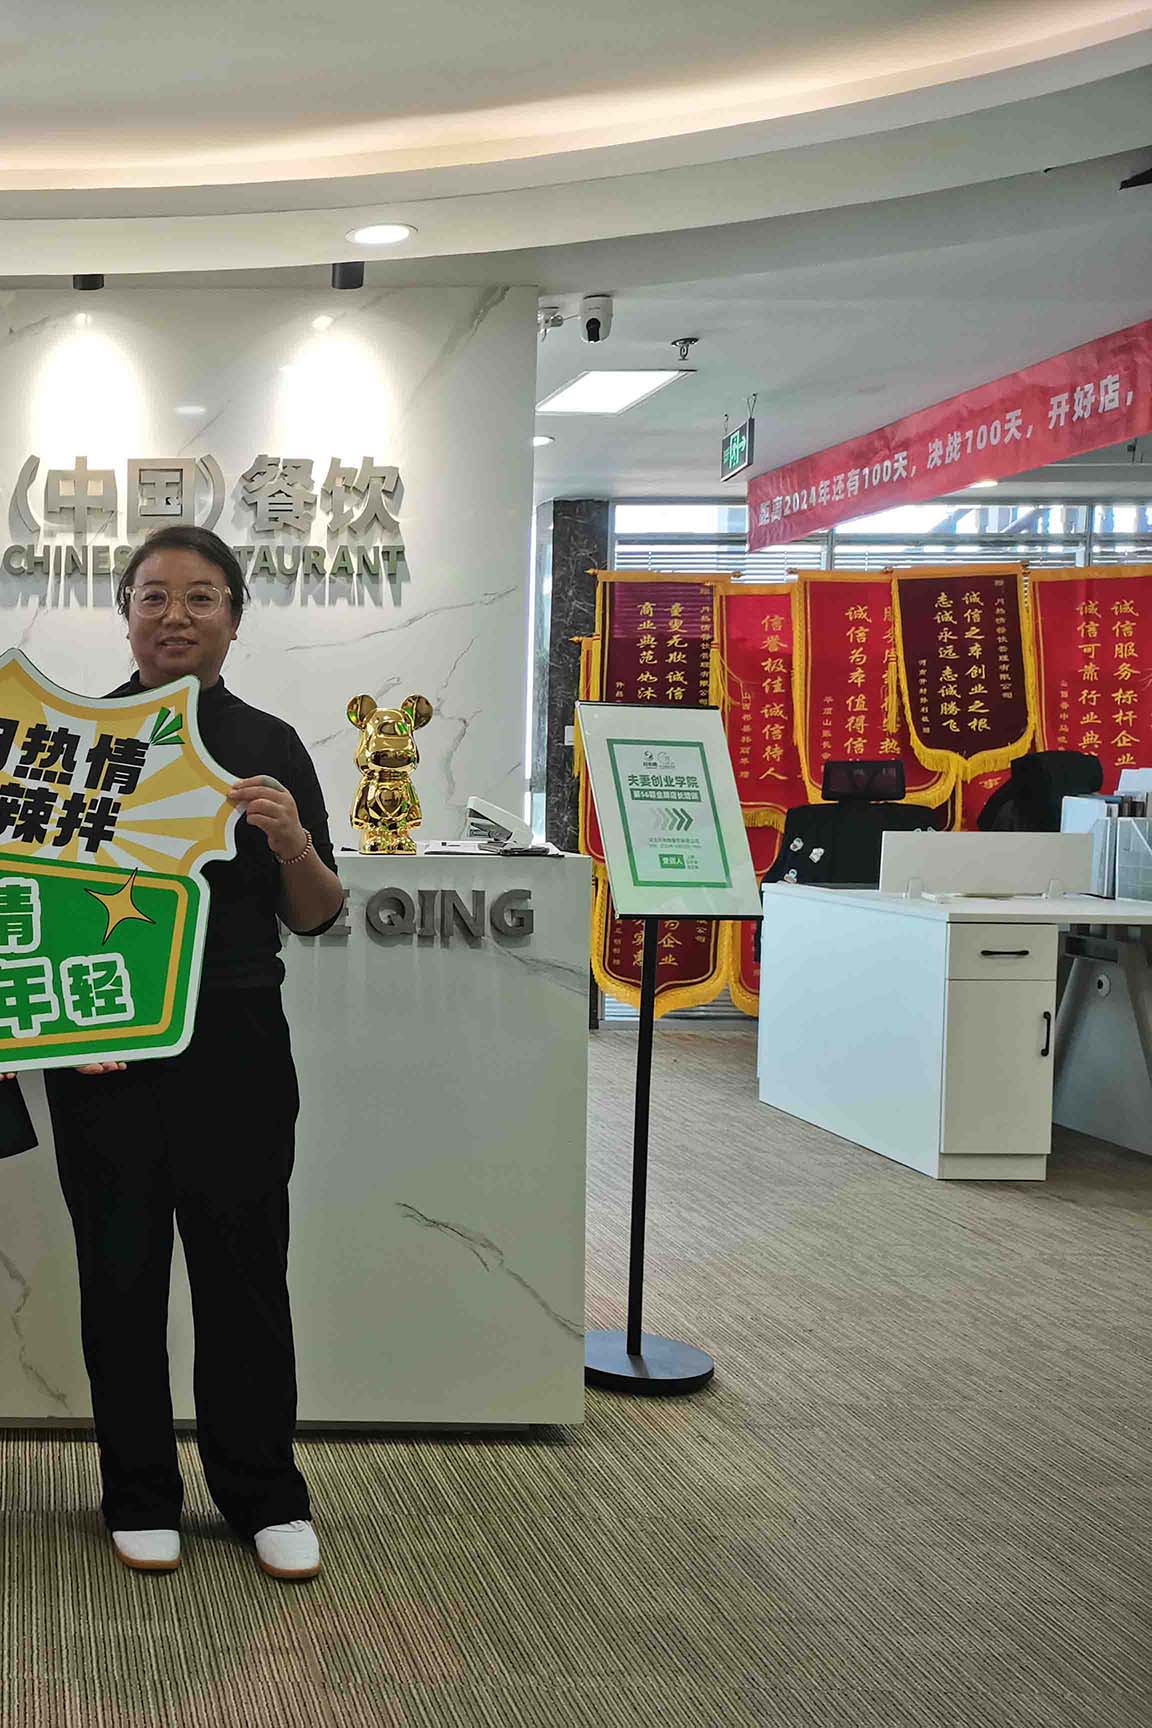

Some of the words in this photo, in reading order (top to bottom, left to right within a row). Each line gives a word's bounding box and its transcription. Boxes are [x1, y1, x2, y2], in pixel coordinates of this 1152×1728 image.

[2, 543, 138, 577] CHINES
[233, 543, 406, 577] TAURANT
[759, 614, 789, 780] 信誉极佳诚信待人
[844, 604, 873, 761] 诚信为本值得信
[962, 591, 991, 732] 诚信之本创业之根
[1076, 600, 1102, 756] 诚信可靠行业典
[1110, 599, 1140, 767] 诚信服务标杆企业
[628, 774, 699, 788] 夫妻创业学院
[366, 886, 534, 938] QING
